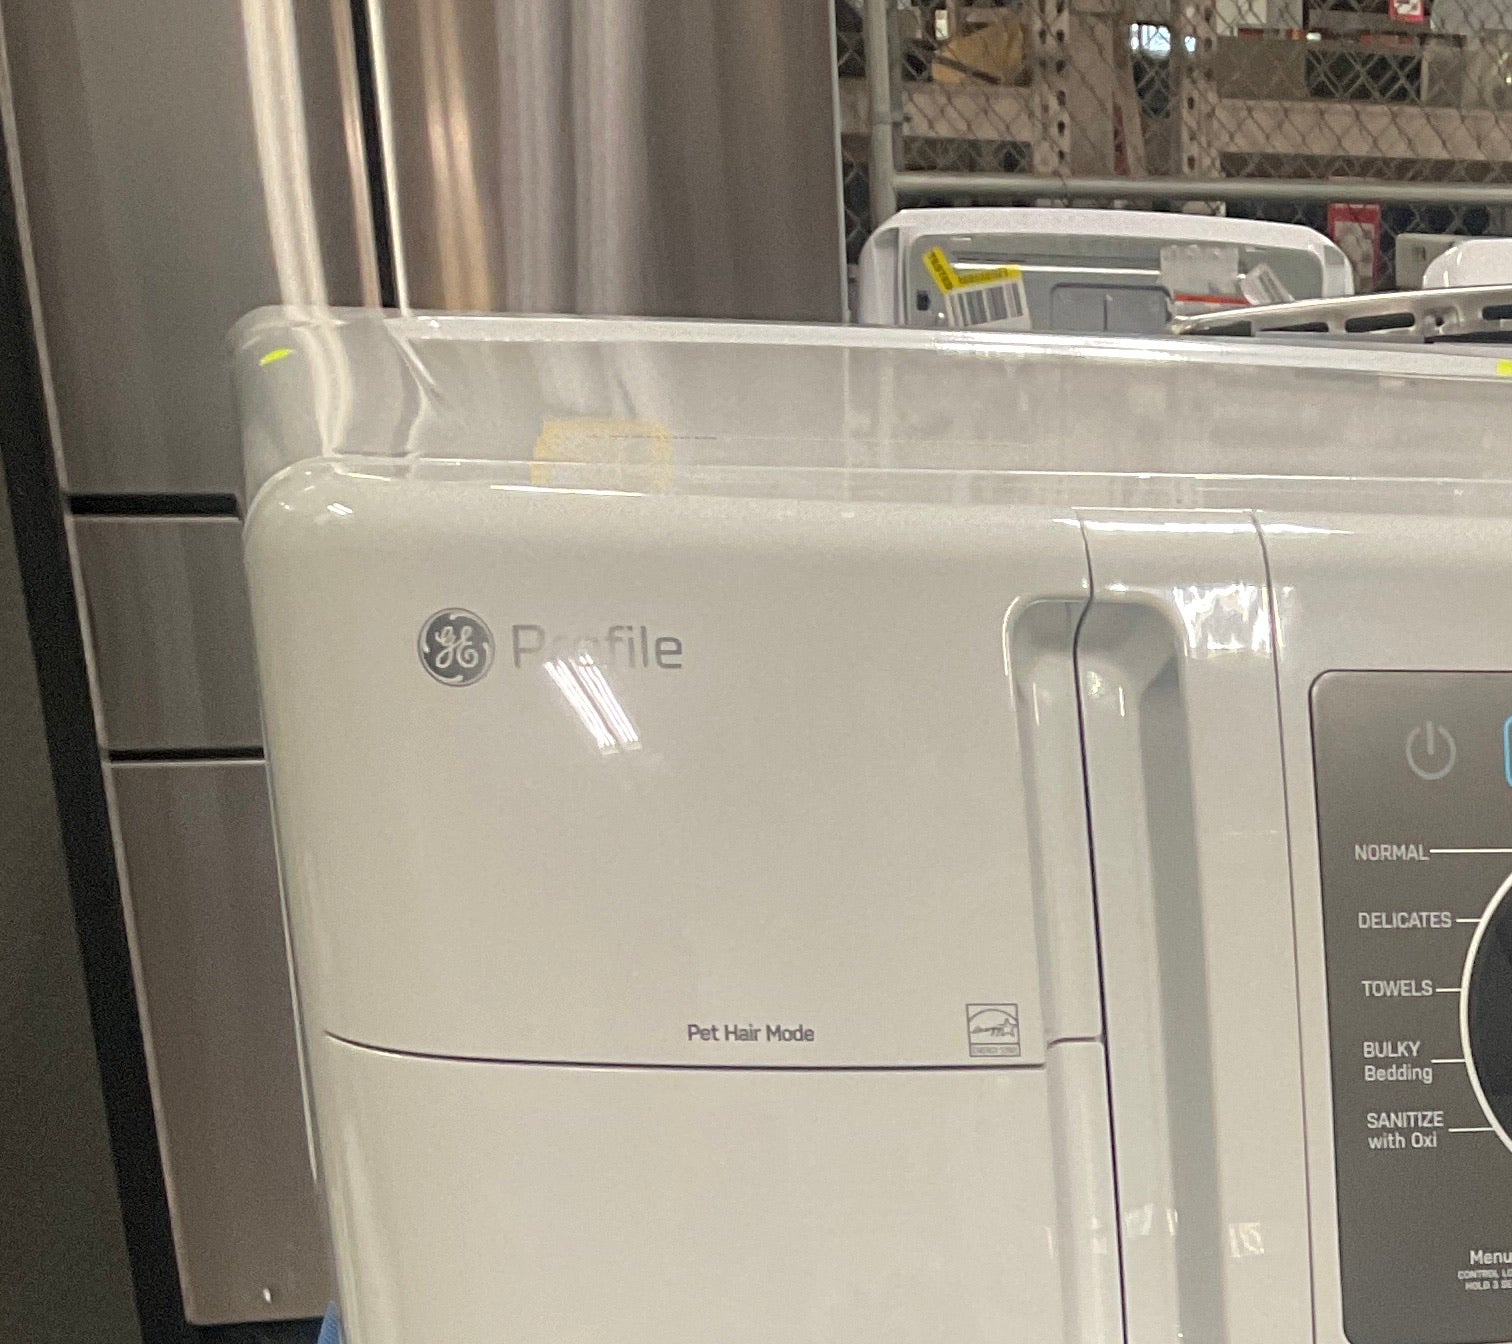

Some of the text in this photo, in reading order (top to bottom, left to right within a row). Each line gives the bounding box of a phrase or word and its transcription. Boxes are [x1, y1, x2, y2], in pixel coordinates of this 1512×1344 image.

[511, 623, 684, 669] Pfile
[1354, 844, 1430, 861] NORMAL
[1357, 911, 1452, 929] DELICATES
[1361, 979, 1433, 997] TOWELS
[686, 1023, 816, 1042] Pet Hair Mode
[1362, 1040, 1421, 1058] BULKY
[1363, 1063, 1434, 1085] Bedding
[1366, 1110, 1445, 1129] SANITIZE
[1367, 1130, 1438, 1149] with Oxi
[1457, 1268, 1500, 1280] CONTROL
[1465, 1280, 1491, 1291] HOLD
